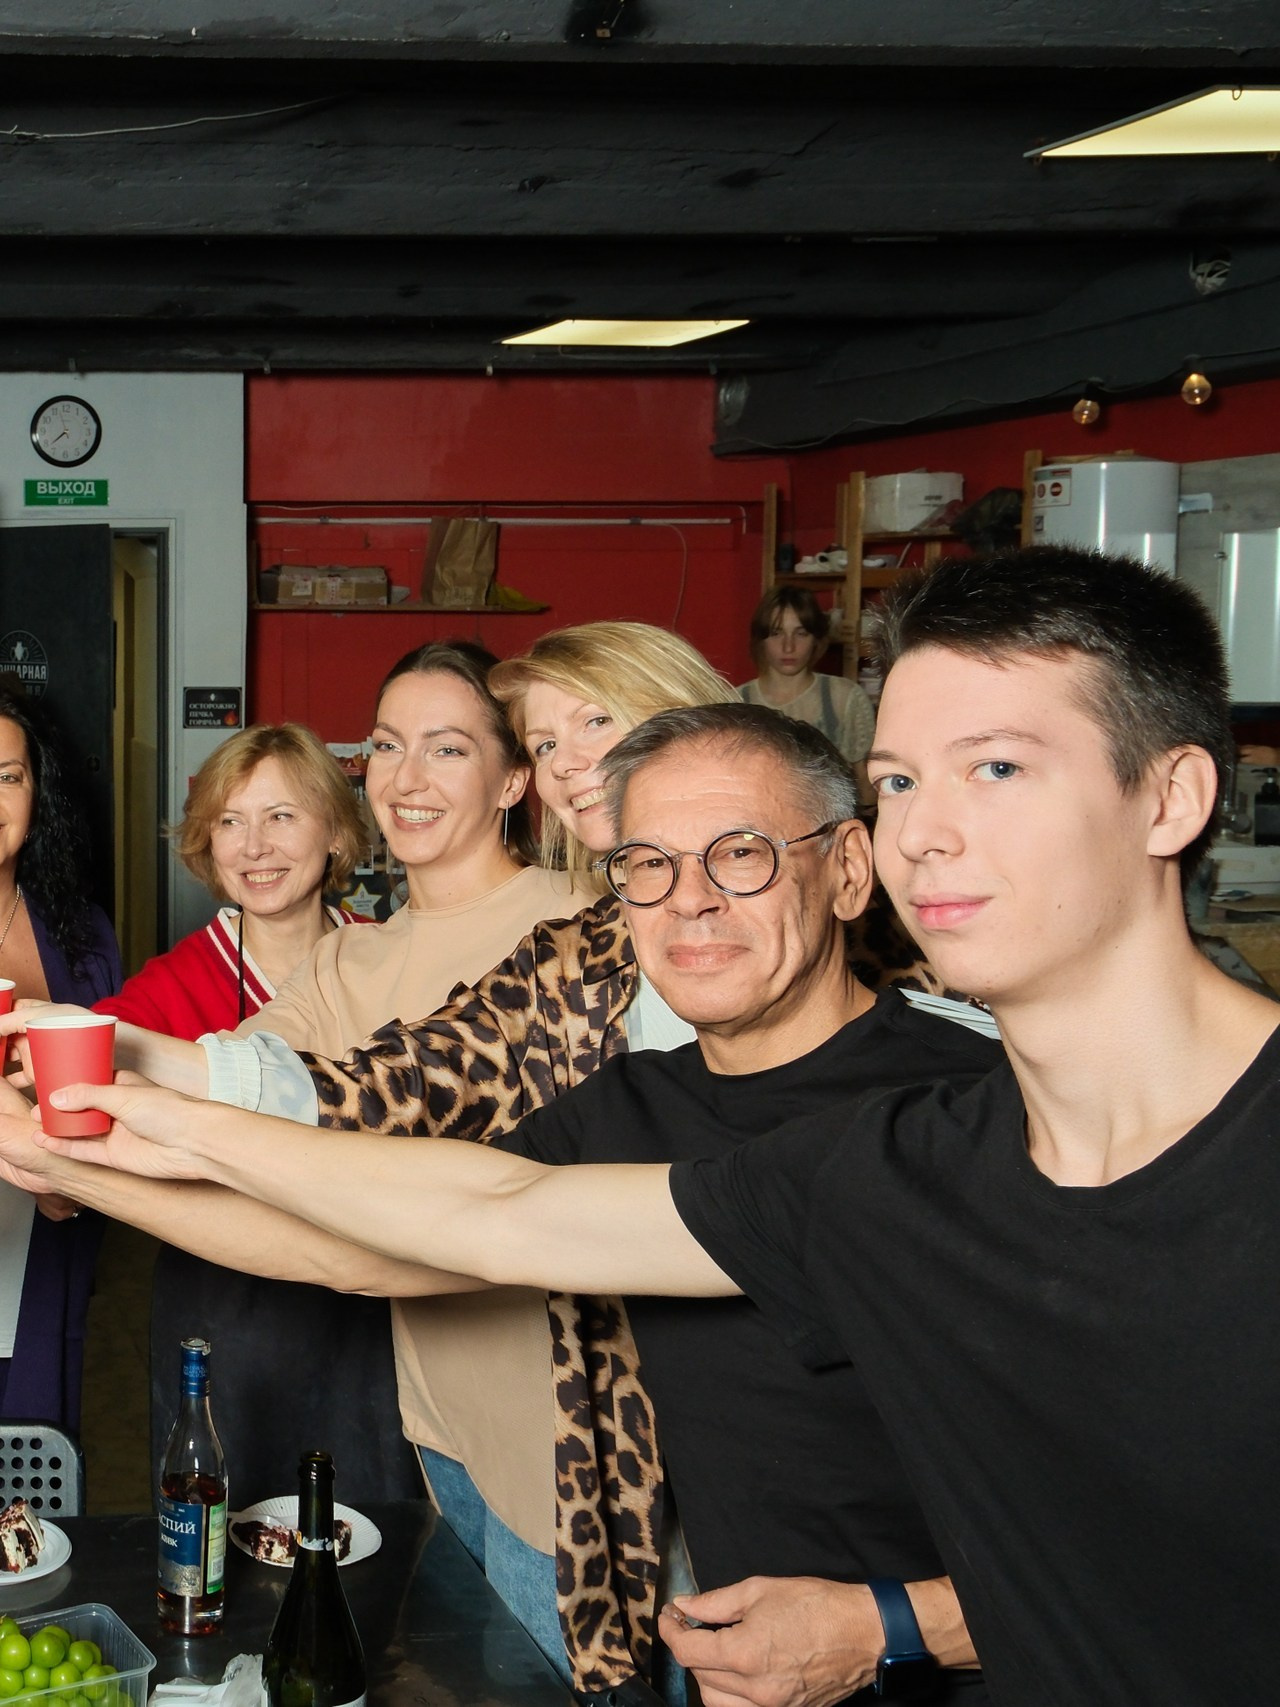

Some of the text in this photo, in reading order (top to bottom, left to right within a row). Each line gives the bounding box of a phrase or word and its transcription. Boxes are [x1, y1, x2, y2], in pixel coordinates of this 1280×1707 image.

[51, 407, 58, 416] 11
[62, 404, 71, 413] 12
[75, 407, 79, 416] 1
[42, 416, 51, 424] 10
[40, 427, 46, 435] 9
[86, 428, 91, 436] 3
[43, 439, 49, 447] 8
[82, 439, 88, 447] 4
[51, 447, 57, 456] 7
[62, 450, 69, 458] 6
[74, 448, 80, 457] 5
[36, 481, 96, 496] ВЫХОД
